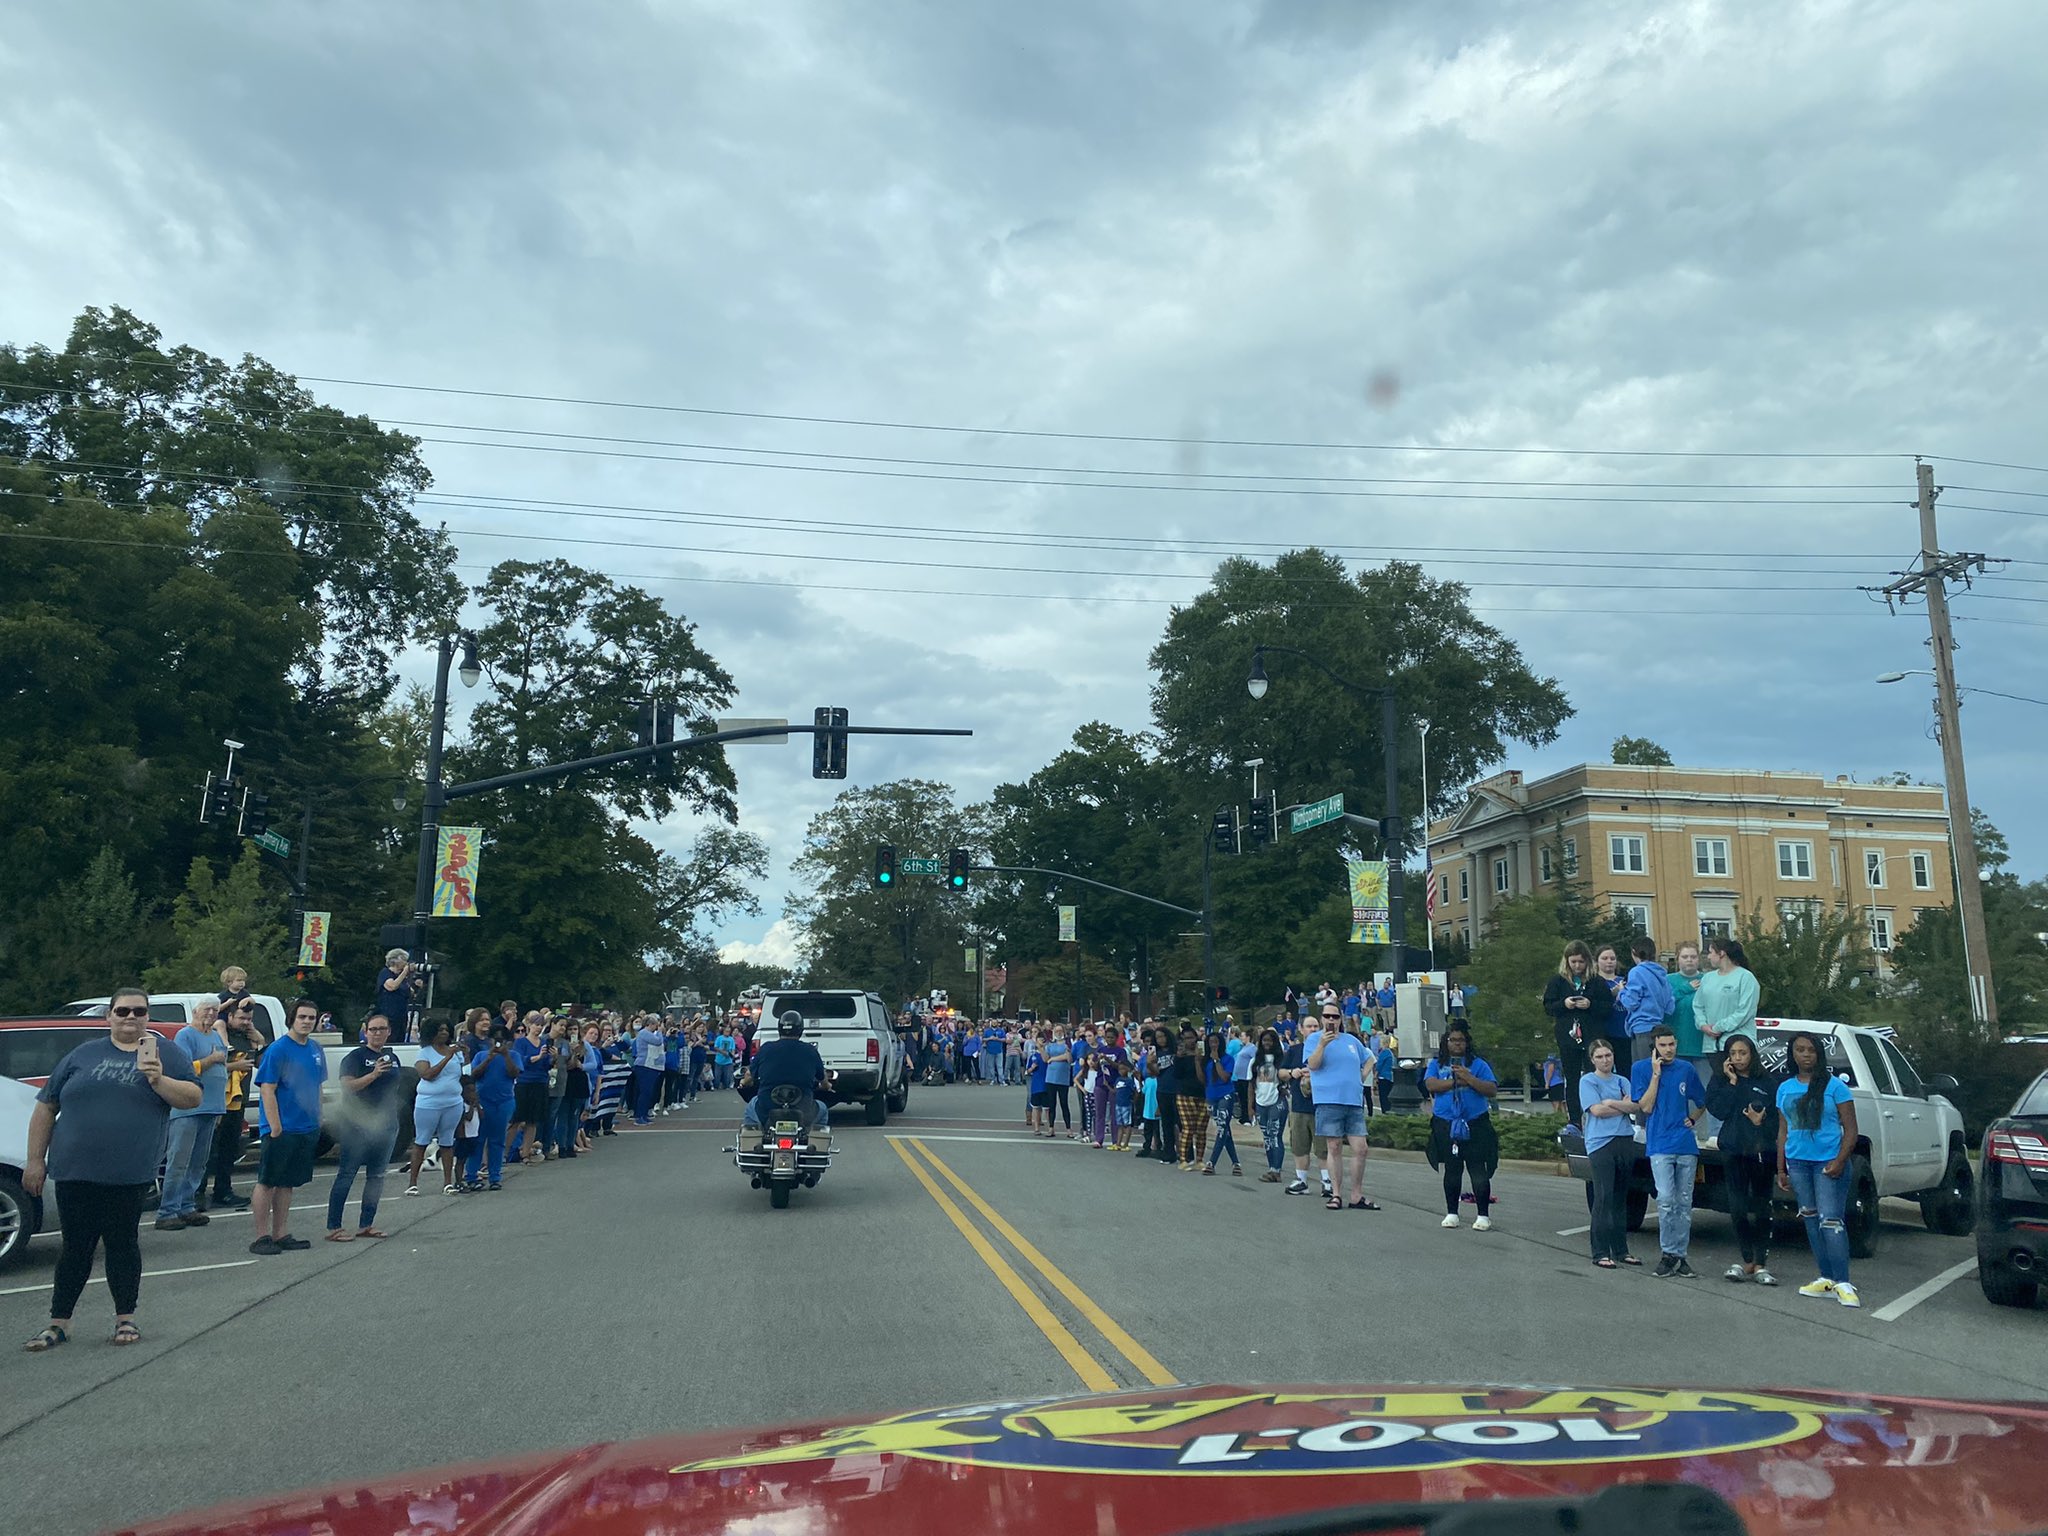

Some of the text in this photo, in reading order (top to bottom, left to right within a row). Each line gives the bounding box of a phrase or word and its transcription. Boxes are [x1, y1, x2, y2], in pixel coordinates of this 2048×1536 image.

[1328, 798, 1341, 815] Ave
[903, 861, 938, 872] 6th St
[1353, 910, 1388, 919] SHEFFIELD
[669, 1391, 1892, 1474] WLAY
[1178, 1420, 1642, 1464] 100.1
